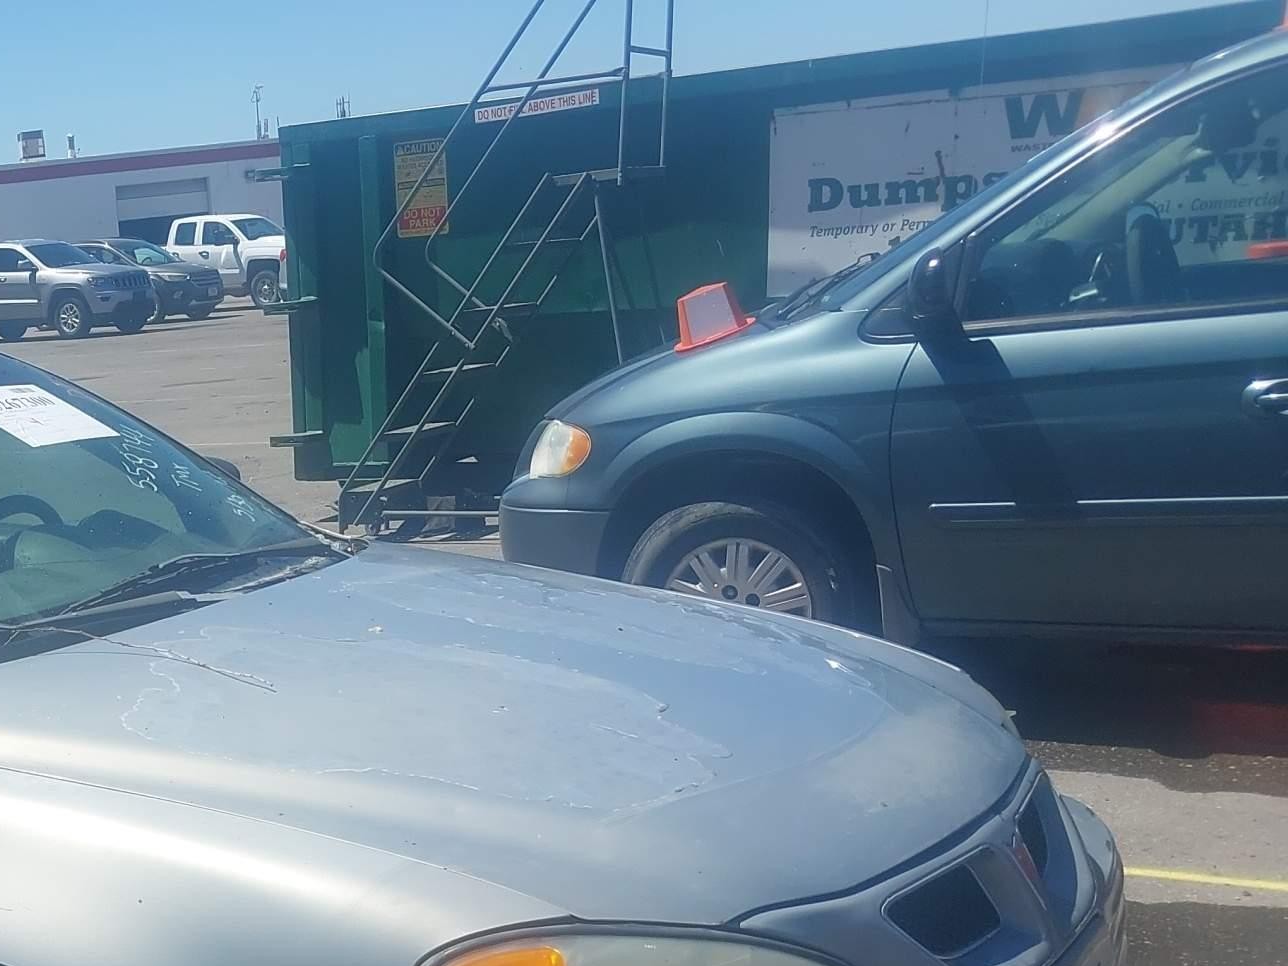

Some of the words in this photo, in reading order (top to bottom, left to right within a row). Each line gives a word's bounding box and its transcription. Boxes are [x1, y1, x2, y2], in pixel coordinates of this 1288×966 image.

[478, 110, 489, 120] DO
[491, 107, 506, 119] NOT
[527, 97, 555, 113] ABOVE
[557, 94, 576, 107] THIS
[578, 91, 597, 104] LINE
[1190, 192, 1285, 211] Commercial
[404, 210, 417, 219] DO
[420, 207, 441, 217] NOT
[409, 218, 436, 229] PARK
[809, 222, 878, 239] Temporary
[882, 222, 896, 232] or
